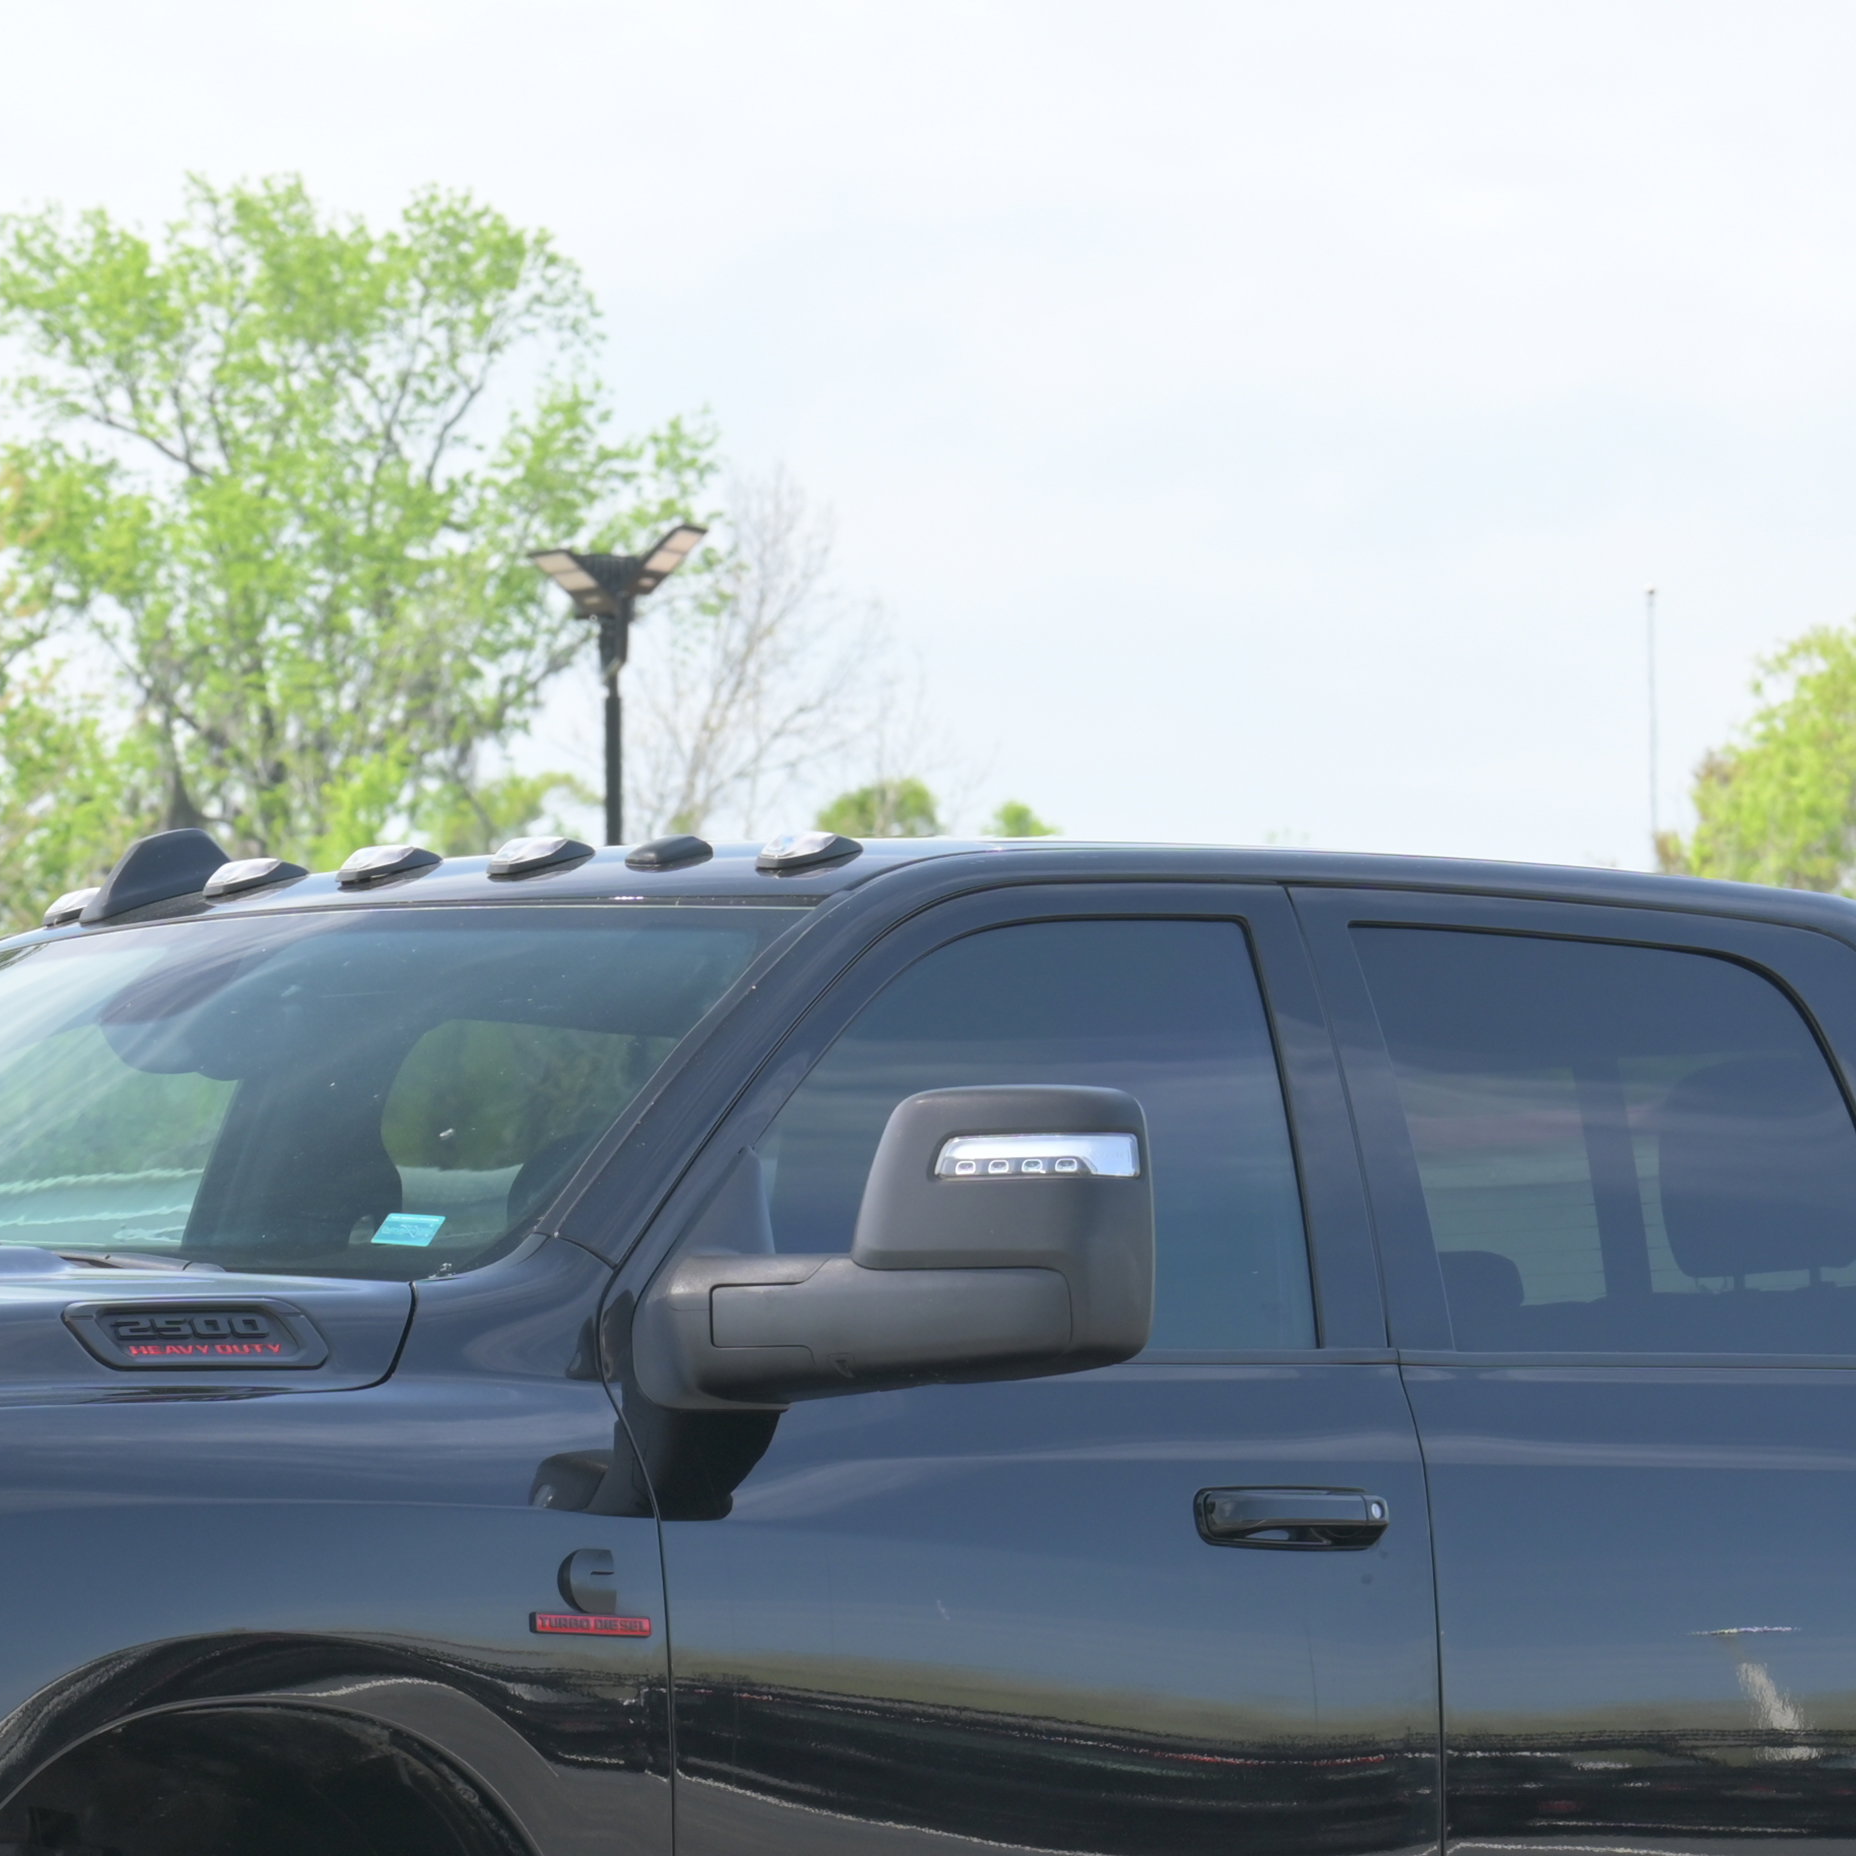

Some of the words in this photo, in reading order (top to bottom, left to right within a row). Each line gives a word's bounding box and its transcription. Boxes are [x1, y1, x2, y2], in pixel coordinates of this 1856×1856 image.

[109, 1317, 269, 1341] 2500
[128, 1343, 210, 1357] HEAVY
[214, 1343, 283, 1355] DUTY
[538, 1615, 592, 1631] TURBO
[594, 1616, 648, 1633] DIESEL
